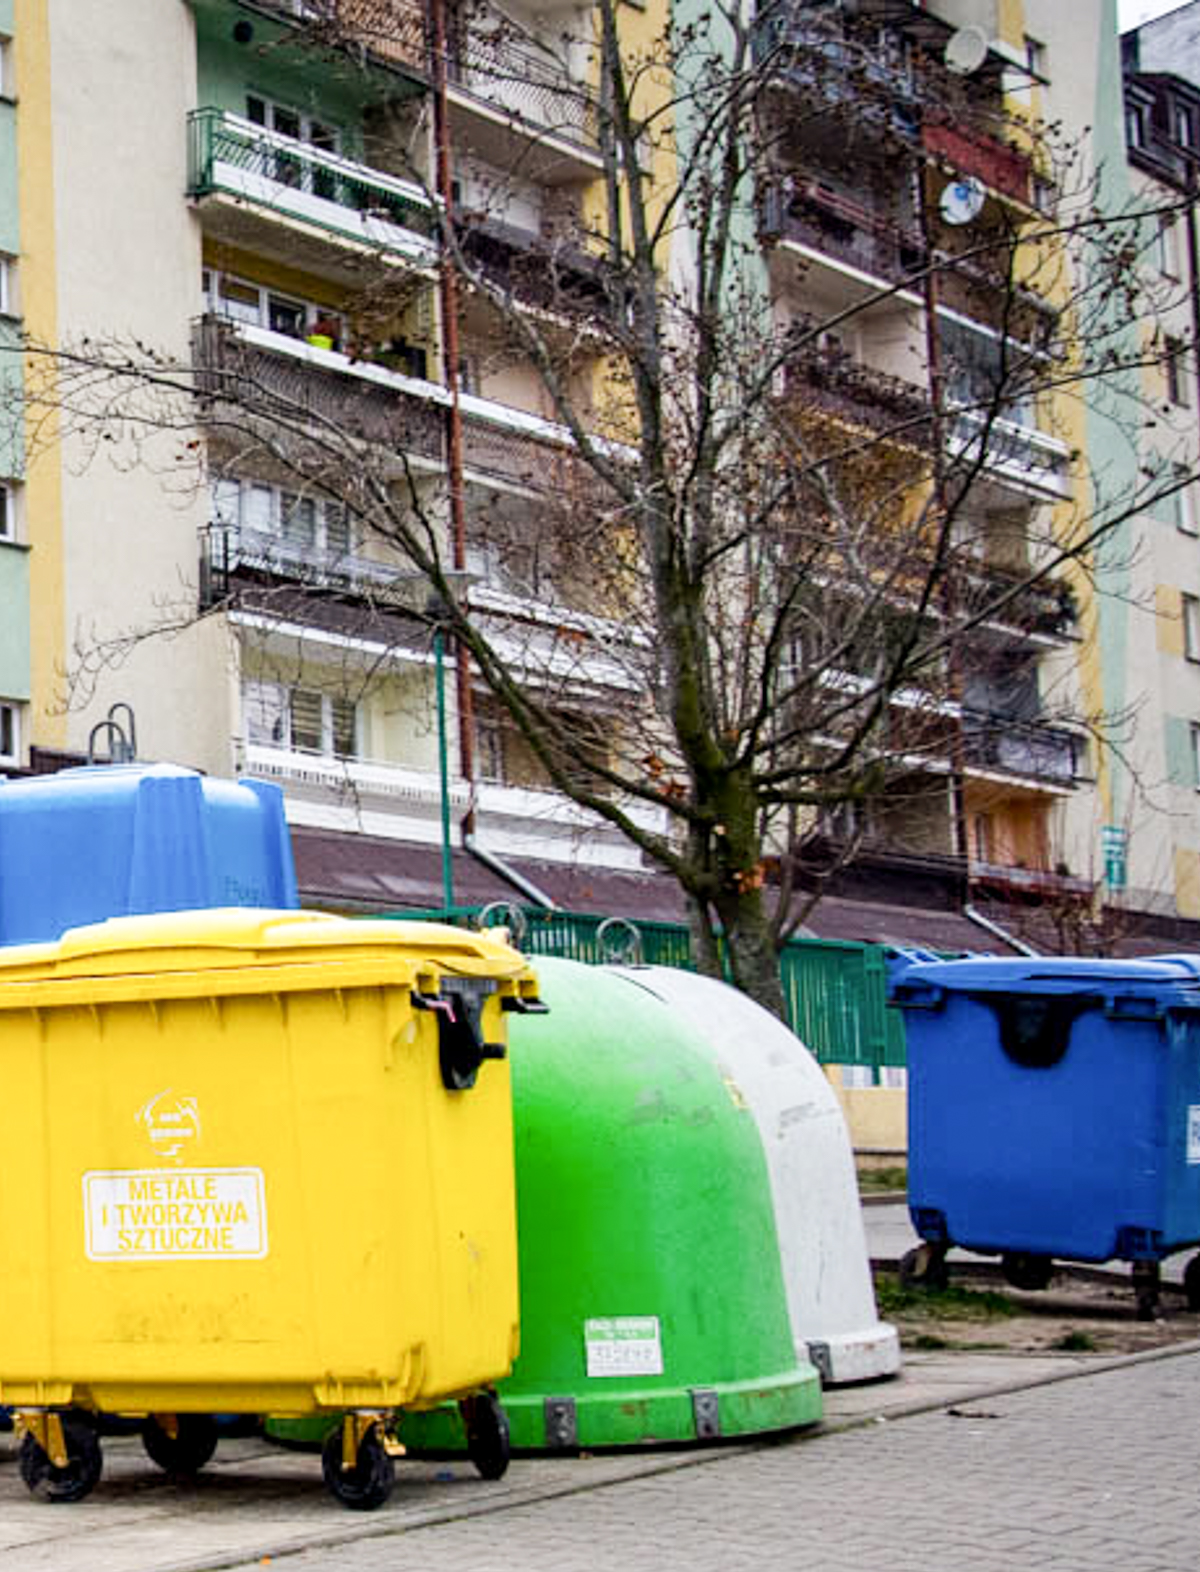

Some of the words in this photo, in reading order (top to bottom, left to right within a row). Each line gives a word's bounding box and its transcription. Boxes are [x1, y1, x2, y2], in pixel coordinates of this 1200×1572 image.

[128, 1177, 217, 1201] METALE
[102, 1204, 108, 1226] I
[115, 1202, 248, 1226] TWORZYWA
[118, 1227, 234, 1251] SZTUCZNE
